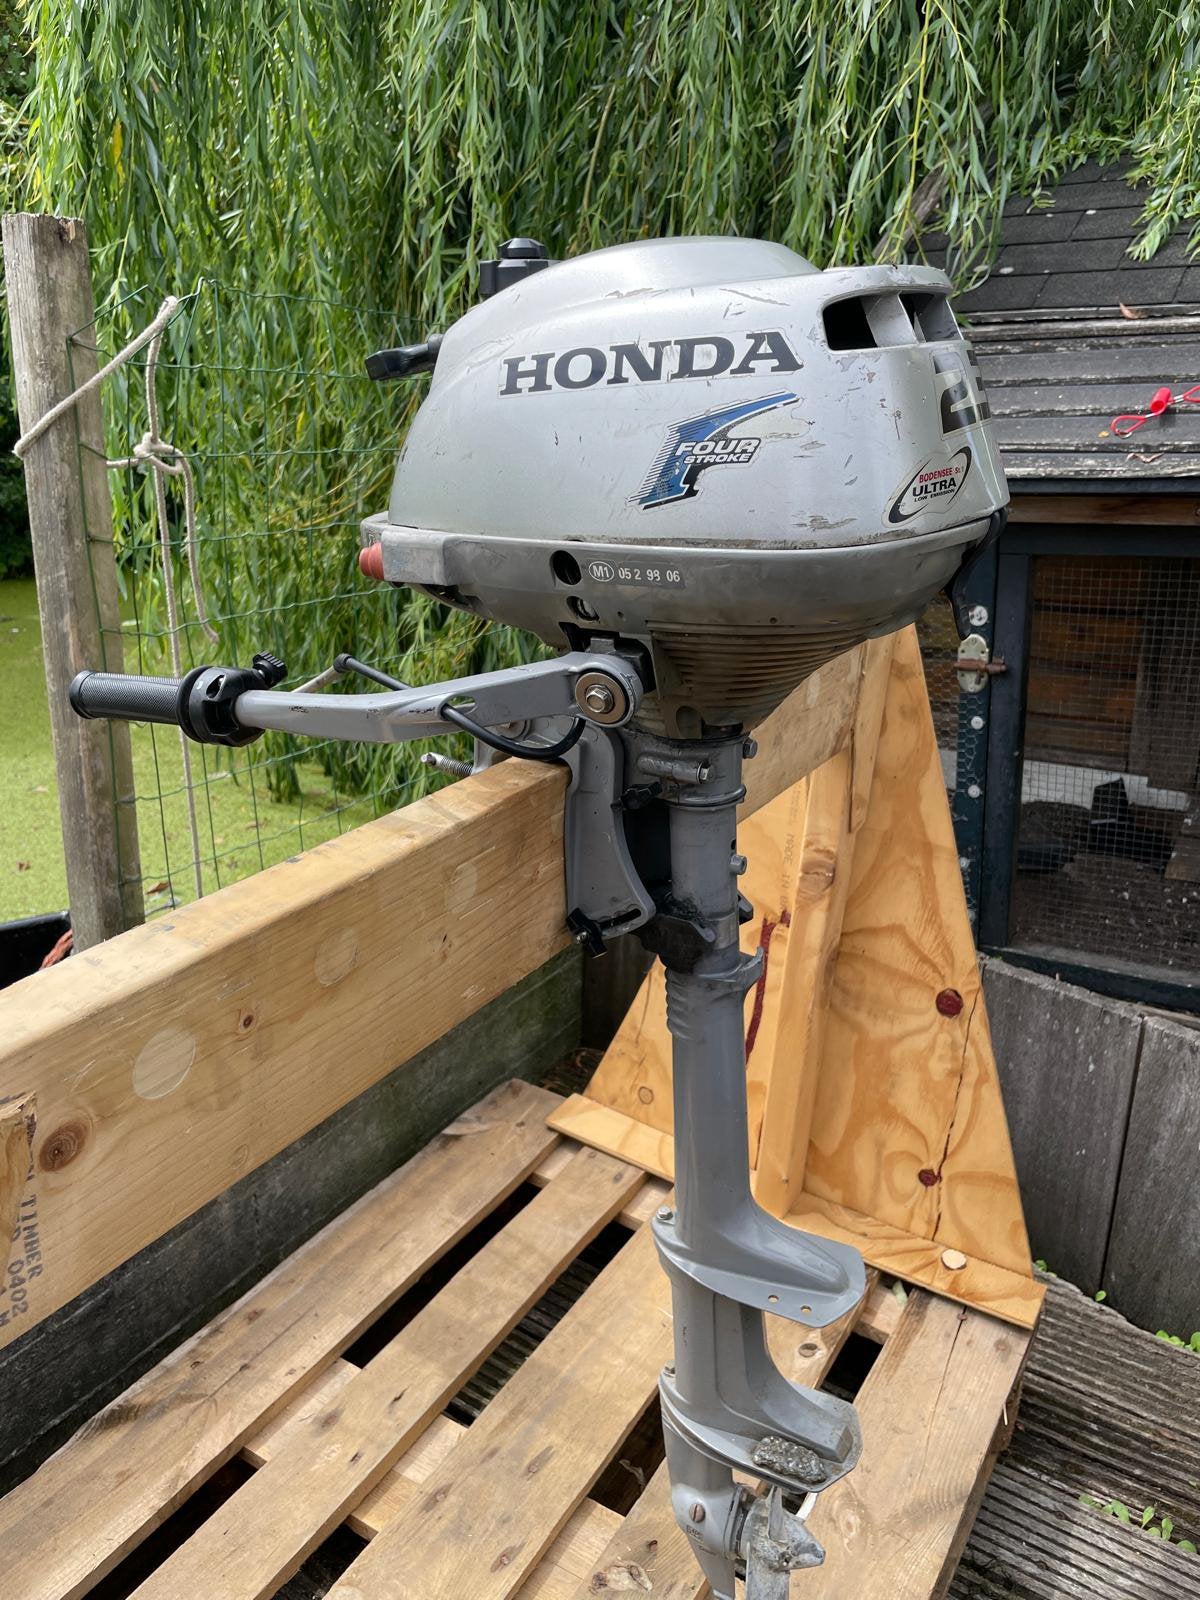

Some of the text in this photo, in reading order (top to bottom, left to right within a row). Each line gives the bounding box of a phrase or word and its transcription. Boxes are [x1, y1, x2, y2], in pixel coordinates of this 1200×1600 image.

[499, 331, 804, 396] HONDA
[675, 439, 760, 456] FOUR
[683, 453, 752, 464] STROKE
[919, 467, 953, 484] BODENSEE
[912, 477, 957, 497] ULTRA
[666, 570, 681, 582] 06
[20, 1194, 43, 1282] TIMBER
[8, 1259, 29, 1317] 0402
